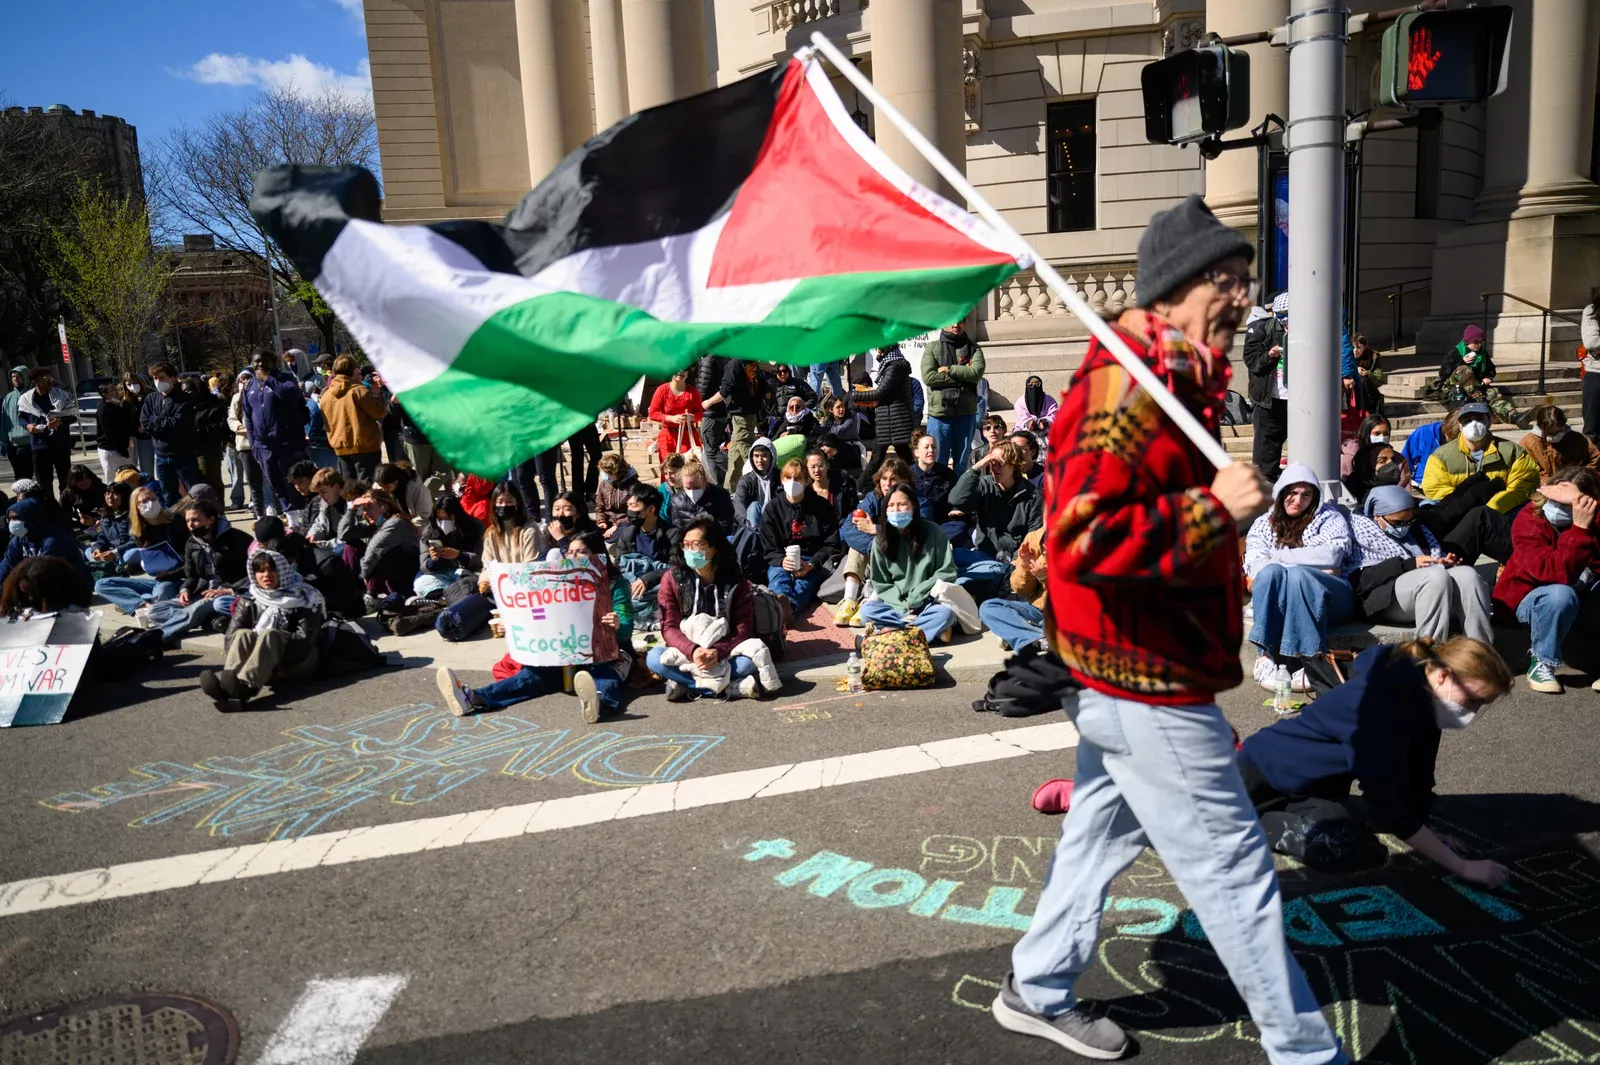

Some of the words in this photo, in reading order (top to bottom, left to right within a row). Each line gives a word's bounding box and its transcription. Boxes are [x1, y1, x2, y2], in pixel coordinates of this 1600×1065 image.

[497, 573, 597, 609] Genocide
[531, 607, 547, 621] =
[510, 623, 591, 654] Ecocide
[0, 644, 71, 669] VEST
[20, 668, 68, 692] WAR
